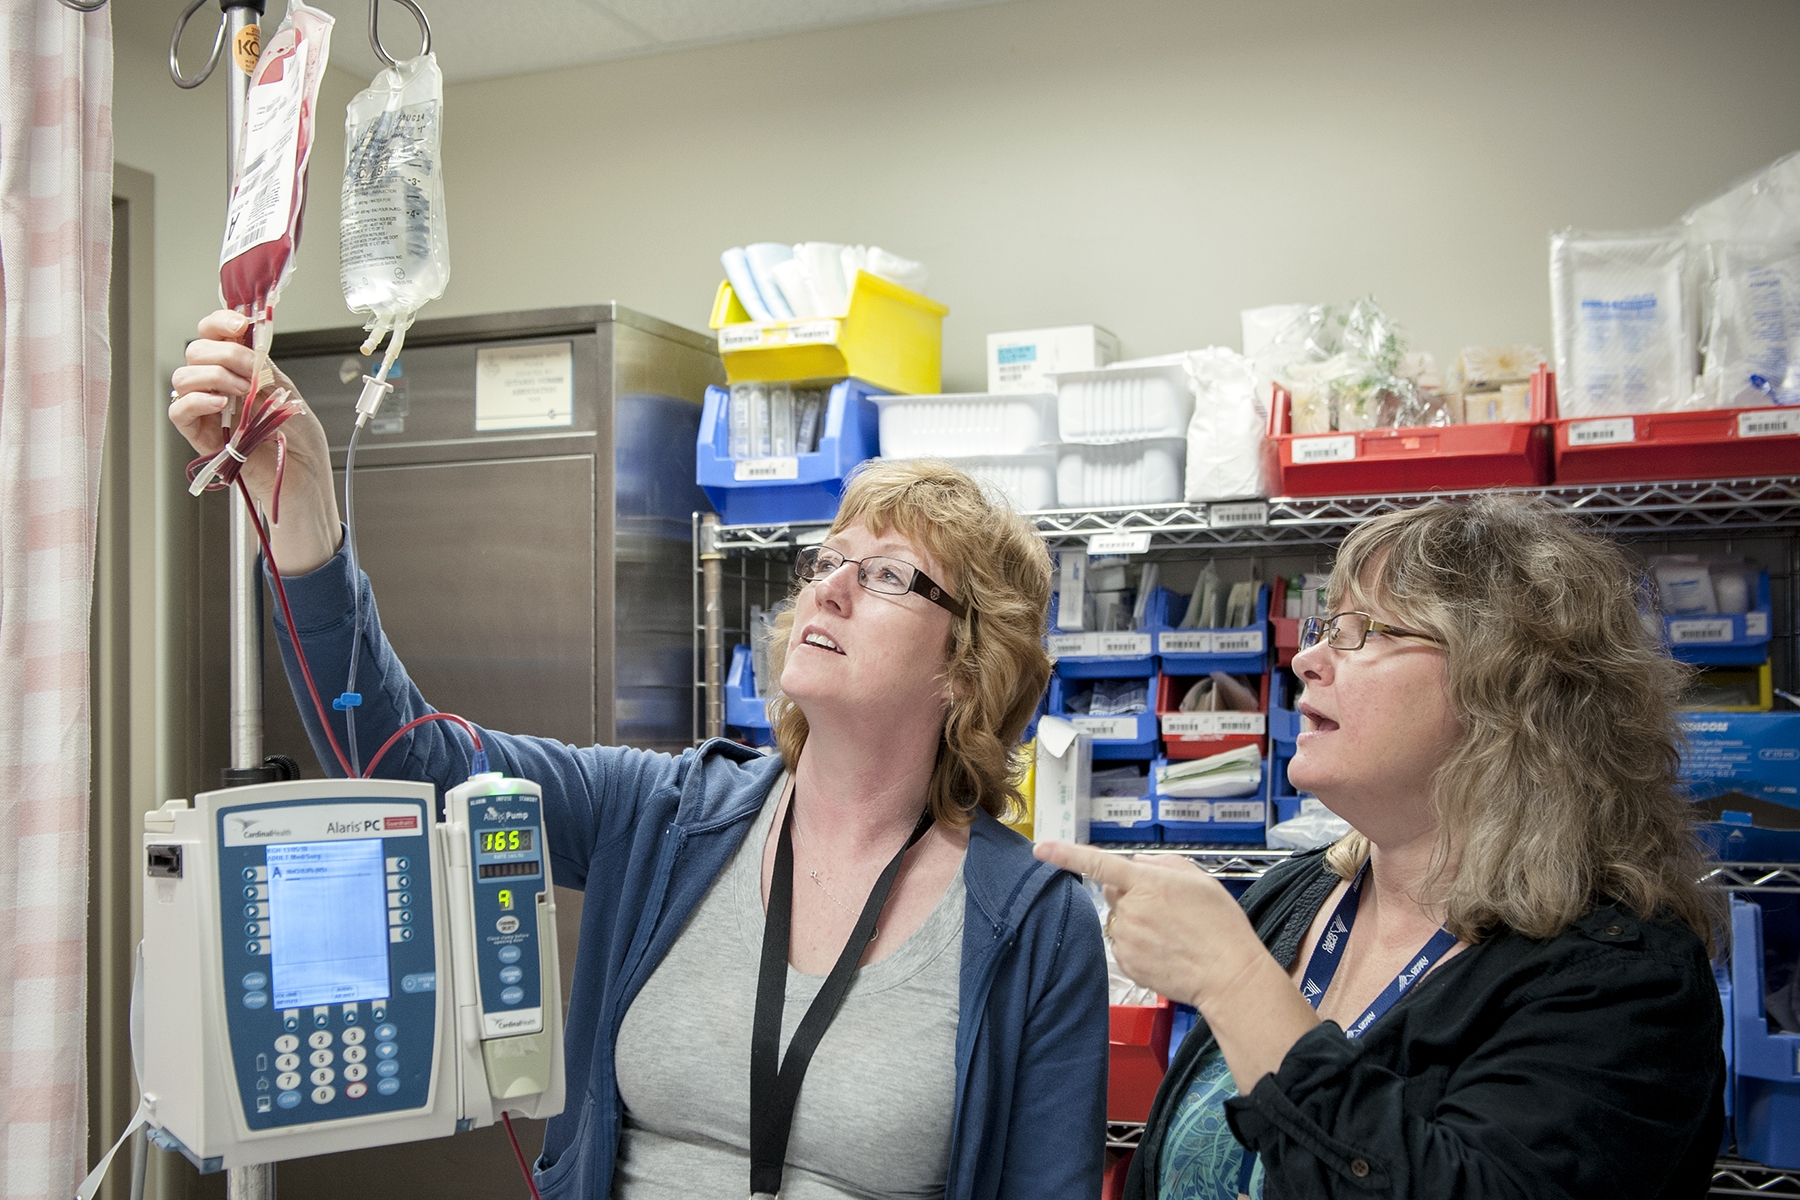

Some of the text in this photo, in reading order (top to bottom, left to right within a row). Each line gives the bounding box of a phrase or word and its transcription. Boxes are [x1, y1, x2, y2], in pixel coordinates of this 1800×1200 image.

[506, 811, 529, 821] Pump
[364, 820, 380, 832] PC
[243, 829, 292, 839] CardinalHealth
[487, 831, 520, 851] 165
[272, 867, 282, 878] A
[498, 1019, 537, 1029] CardinalHealth
[318, 1036, 324, 1045] 2
[350, 1032, 356, 1040] 3
[284, 1039, 289, 1048] 1
[319, 1054, 324, 1063] 5
[352, 1050, 357, 1059] 6
[285, 1058, 291, 1067] 4
[320, 1073, 325, 1081] 8
[352, 1068, 358, 1077] 9
[286, 1077, 292, 1085] 7
[320, 1091, 326, 1100] 0
